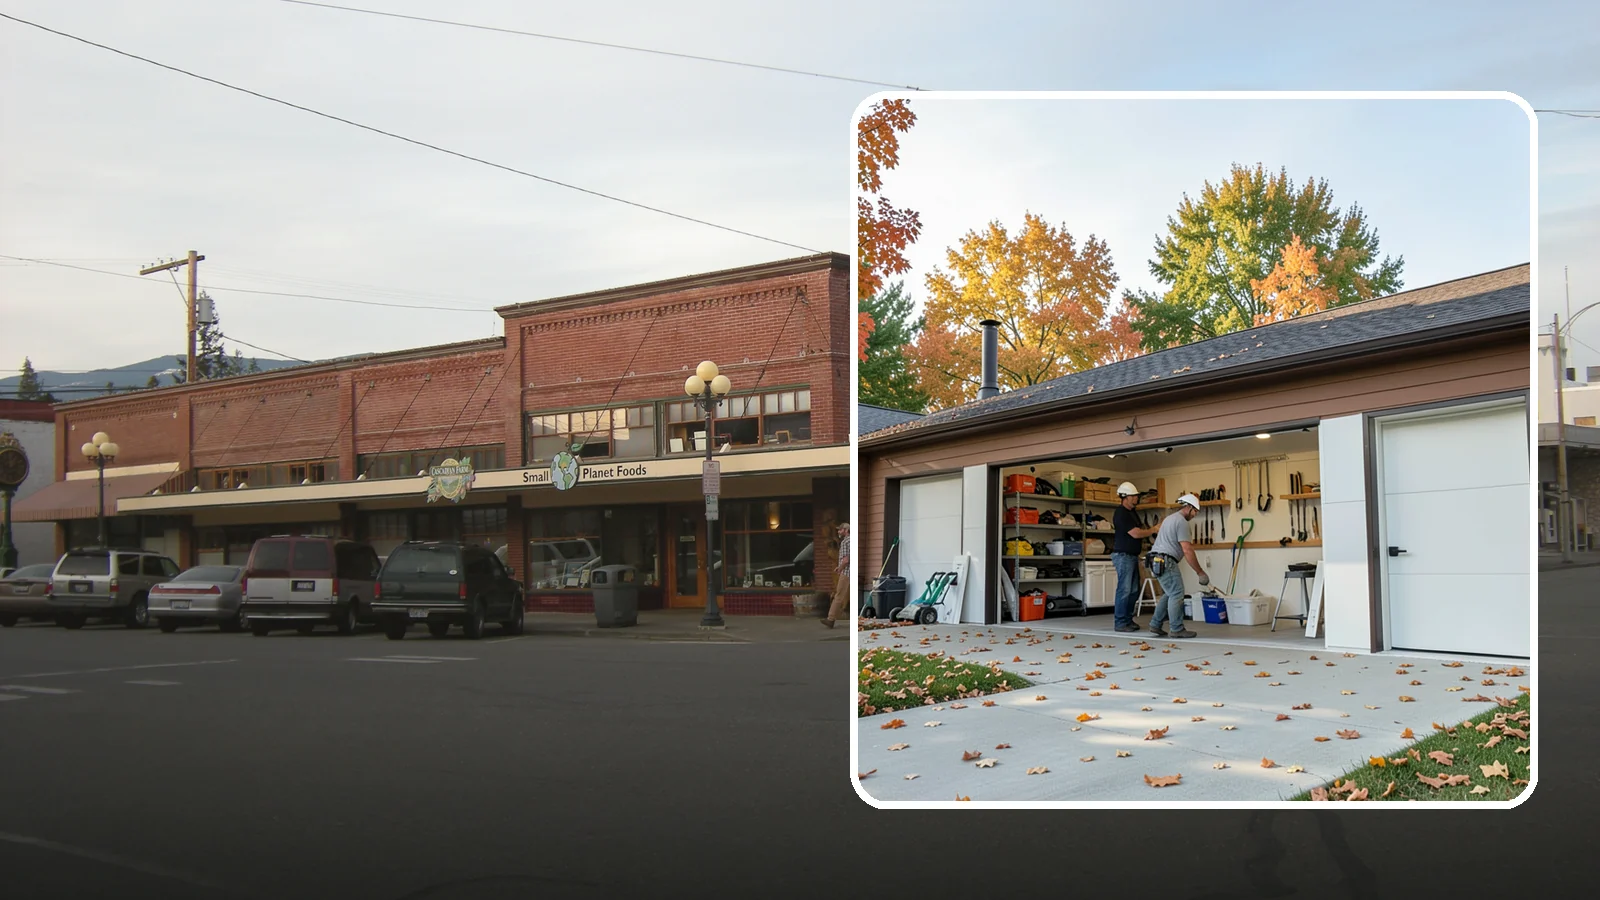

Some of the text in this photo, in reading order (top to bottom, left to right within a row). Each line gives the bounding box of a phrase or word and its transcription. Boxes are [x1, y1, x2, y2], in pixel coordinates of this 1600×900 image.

[523, 464, 647, 482] Small Planet Foods
